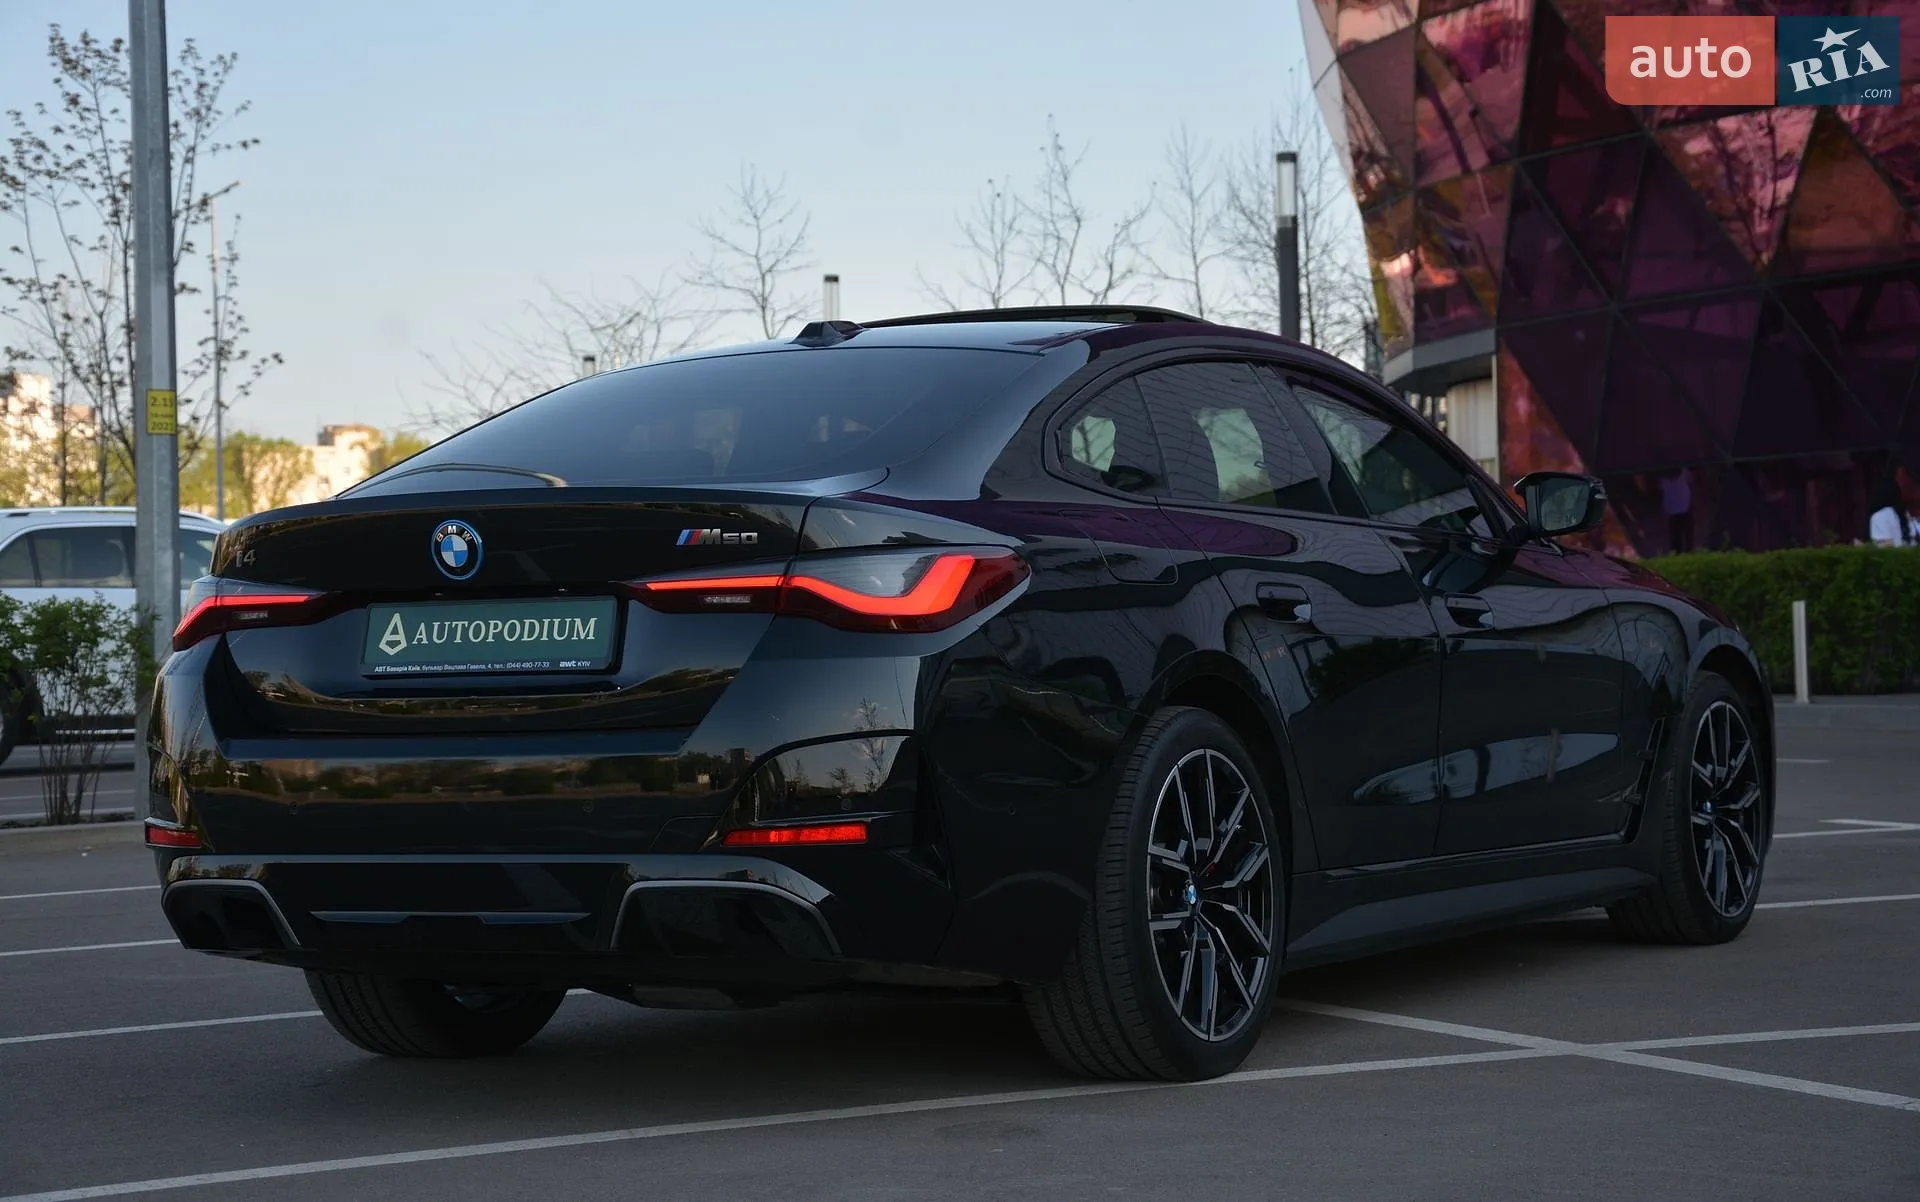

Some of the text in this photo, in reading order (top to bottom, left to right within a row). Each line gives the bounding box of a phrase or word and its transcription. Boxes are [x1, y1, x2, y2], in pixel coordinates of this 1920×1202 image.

[436, 525, 473, 542] BMW
[700, 528, 758, 545] M50
[412, 617, 598, 645] AUTOPODIUM
